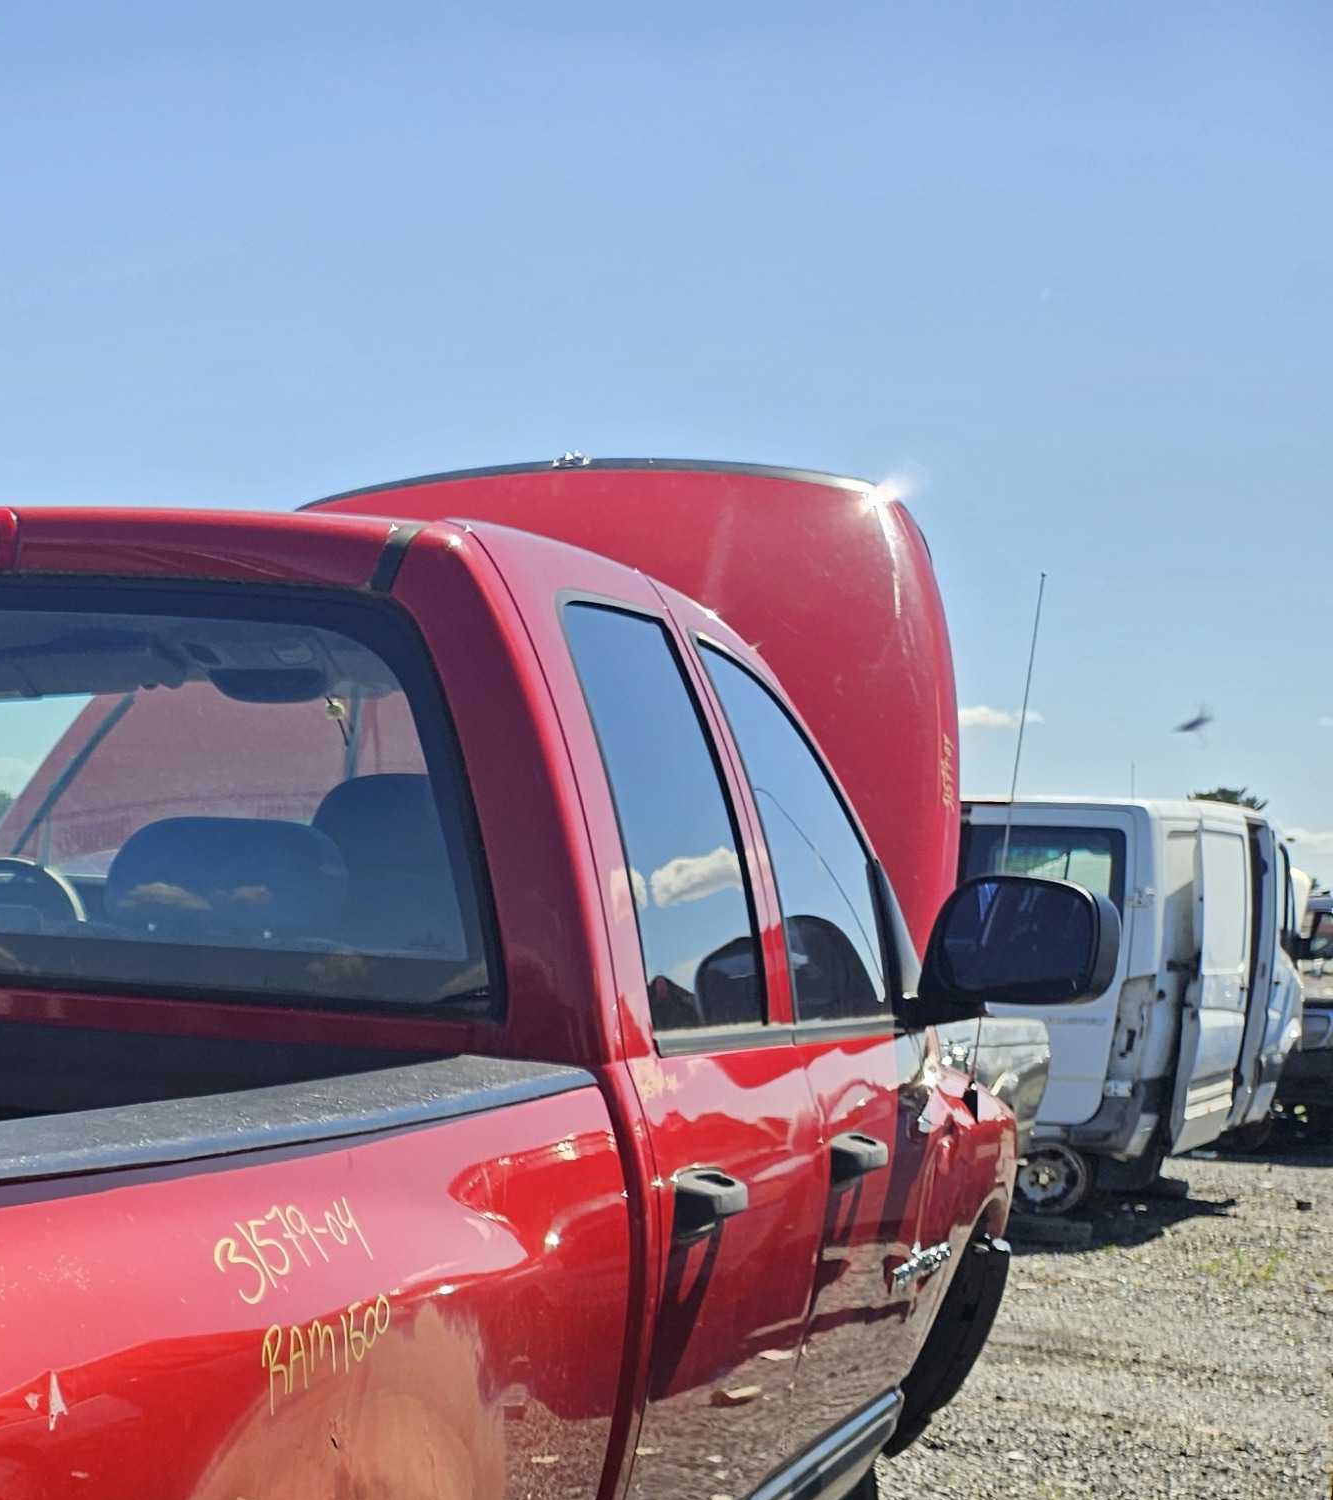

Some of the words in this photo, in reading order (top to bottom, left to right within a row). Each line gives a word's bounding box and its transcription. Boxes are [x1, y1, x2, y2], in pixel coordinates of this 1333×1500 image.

[213, 1196, 374, 1305] 31579-04
[261, 1319, 337, 1417] RAM
[340, 1293, 391, 1374] 1500
